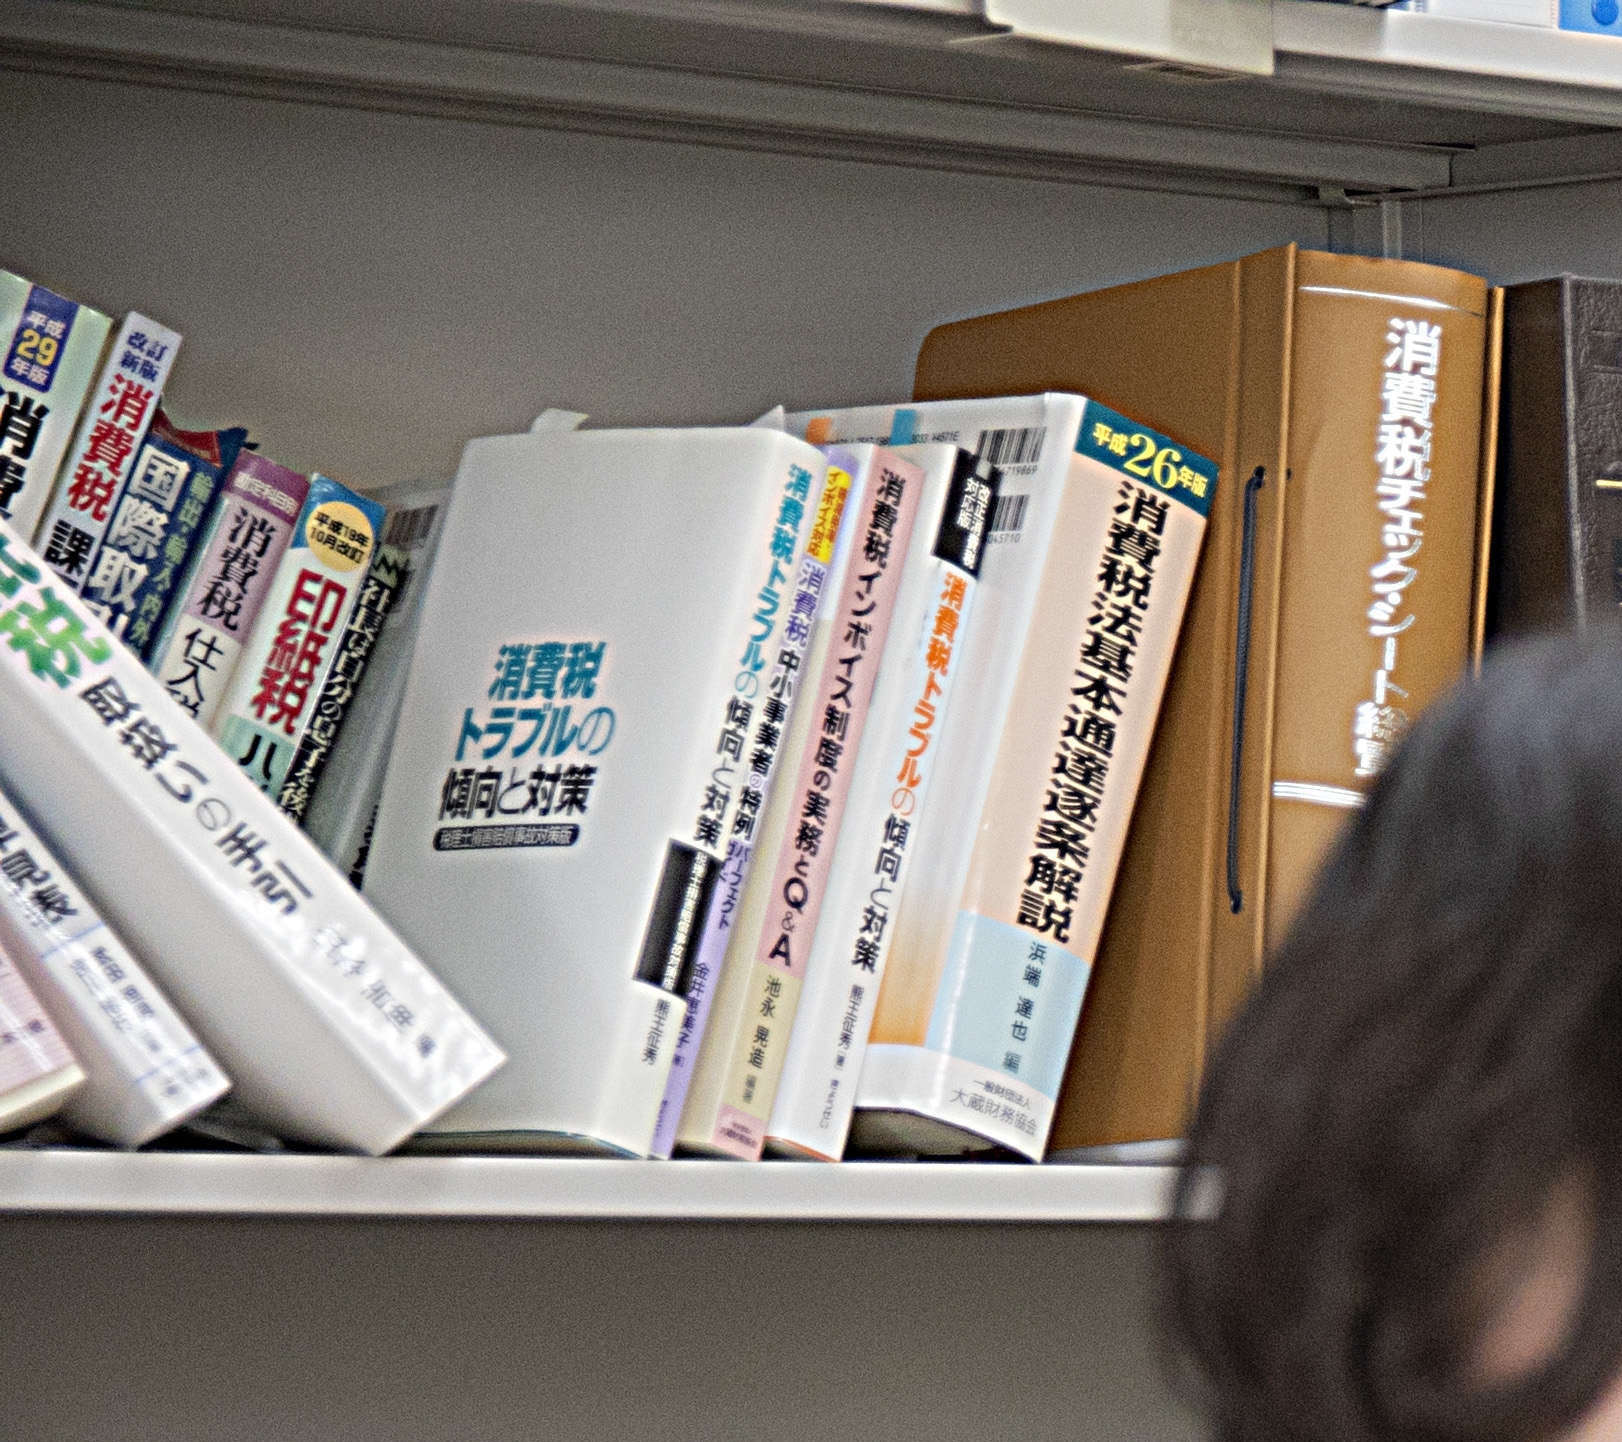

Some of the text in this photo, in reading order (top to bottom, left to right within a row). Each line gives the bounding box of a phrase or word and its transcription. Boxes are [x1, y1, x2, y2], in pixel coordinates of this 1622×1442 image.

[17, 328, 59, 367] 29
[27, 310, 66, 339] 平成
[10, 354, 49, 388] 年版
[1092, 421, 1208, 499] 平成26年版
[251, 566, 348, 738] 印紙税
[489, 640, 607, 700] 消費税
[693, 463, 813, 850] 消費税トラブルの傾向と対策
[452, 706, 617, 761] トラブルの
[1015, 478, 1174, 945] 消費税法基本通達逐条解説
[437, 764, 601, 822] 傾向と対策
[849, 570, 970, 975] 消費税トラブルの傾向と対策
